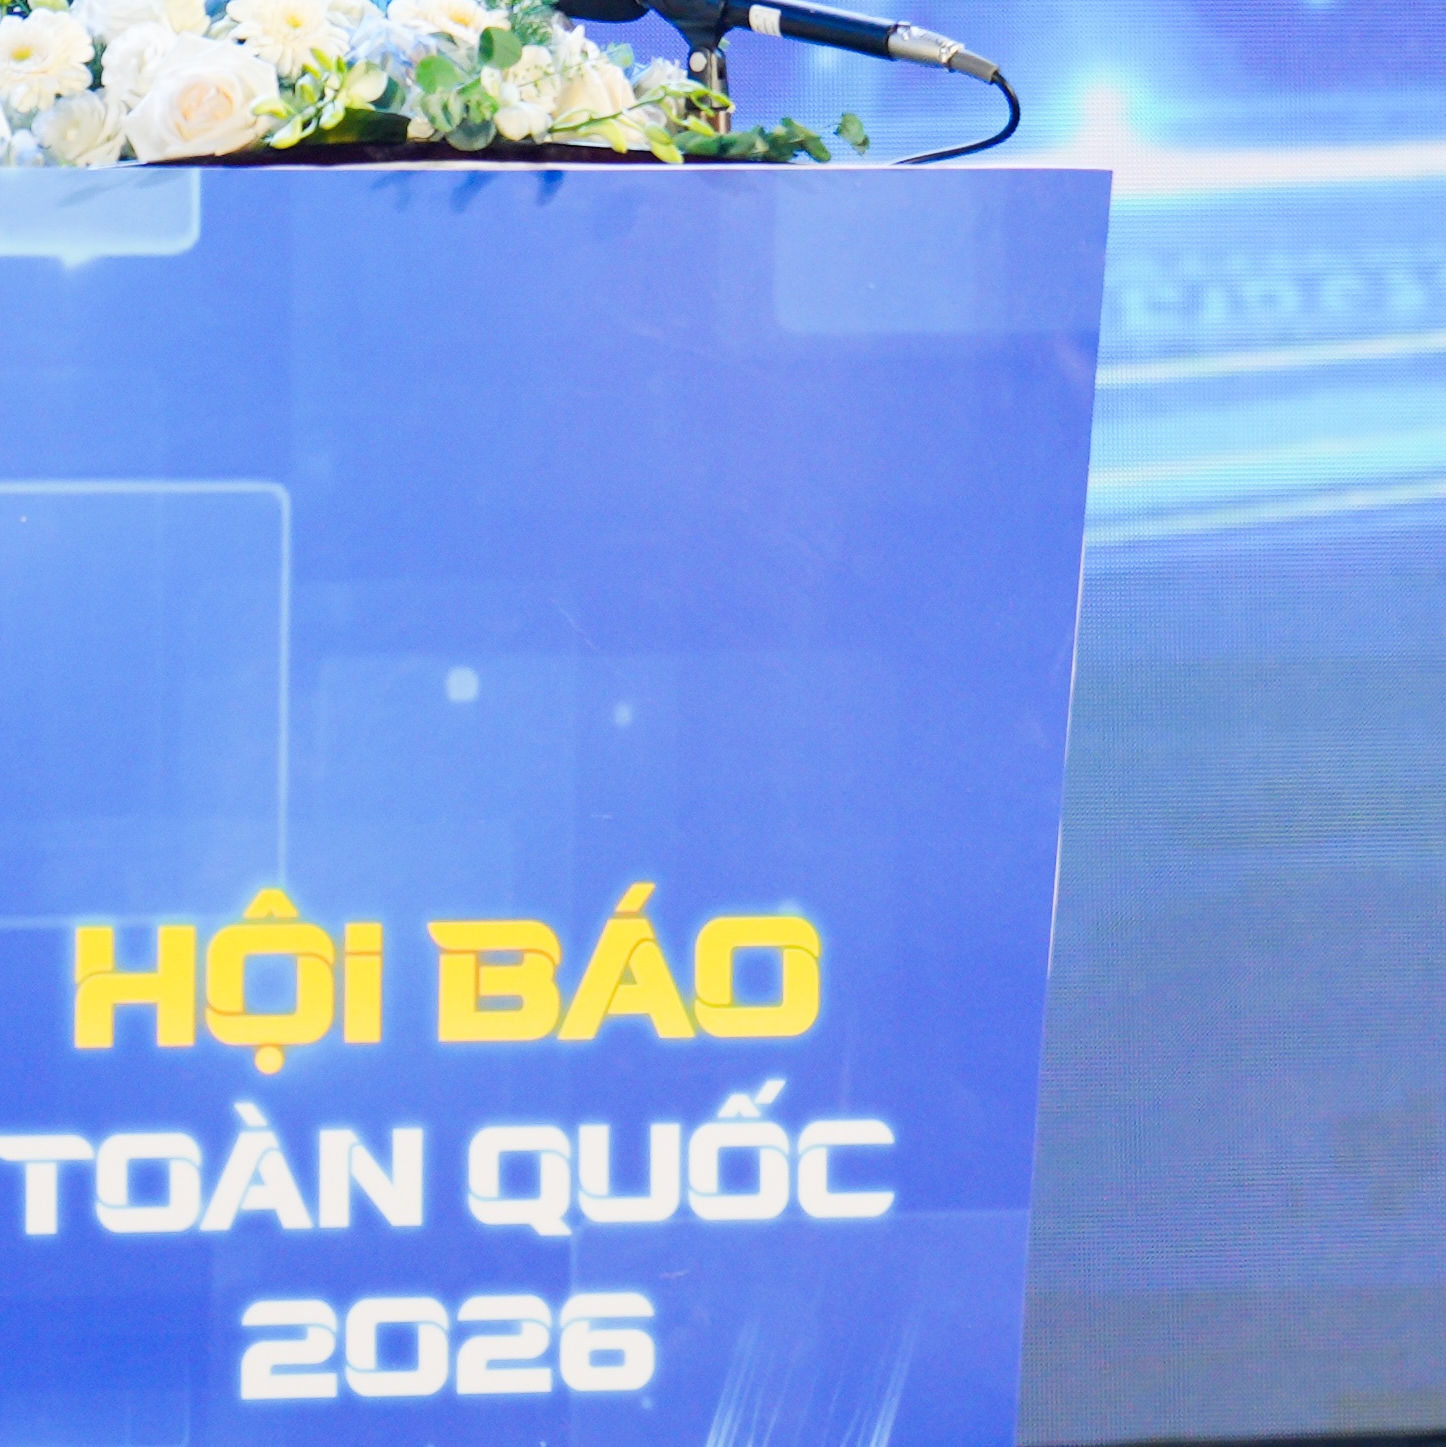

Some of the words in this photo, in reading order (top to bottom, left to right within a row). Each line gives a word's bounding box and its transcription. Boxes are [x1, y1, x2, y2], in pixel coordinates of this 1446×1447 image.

[74, 888, 383, 1075] HỘI
[427, 883, 821, 1043] BÁO
[467, 1079, 895, 1236] QUỐC
[240, 1291, 656, 1400] 2026
